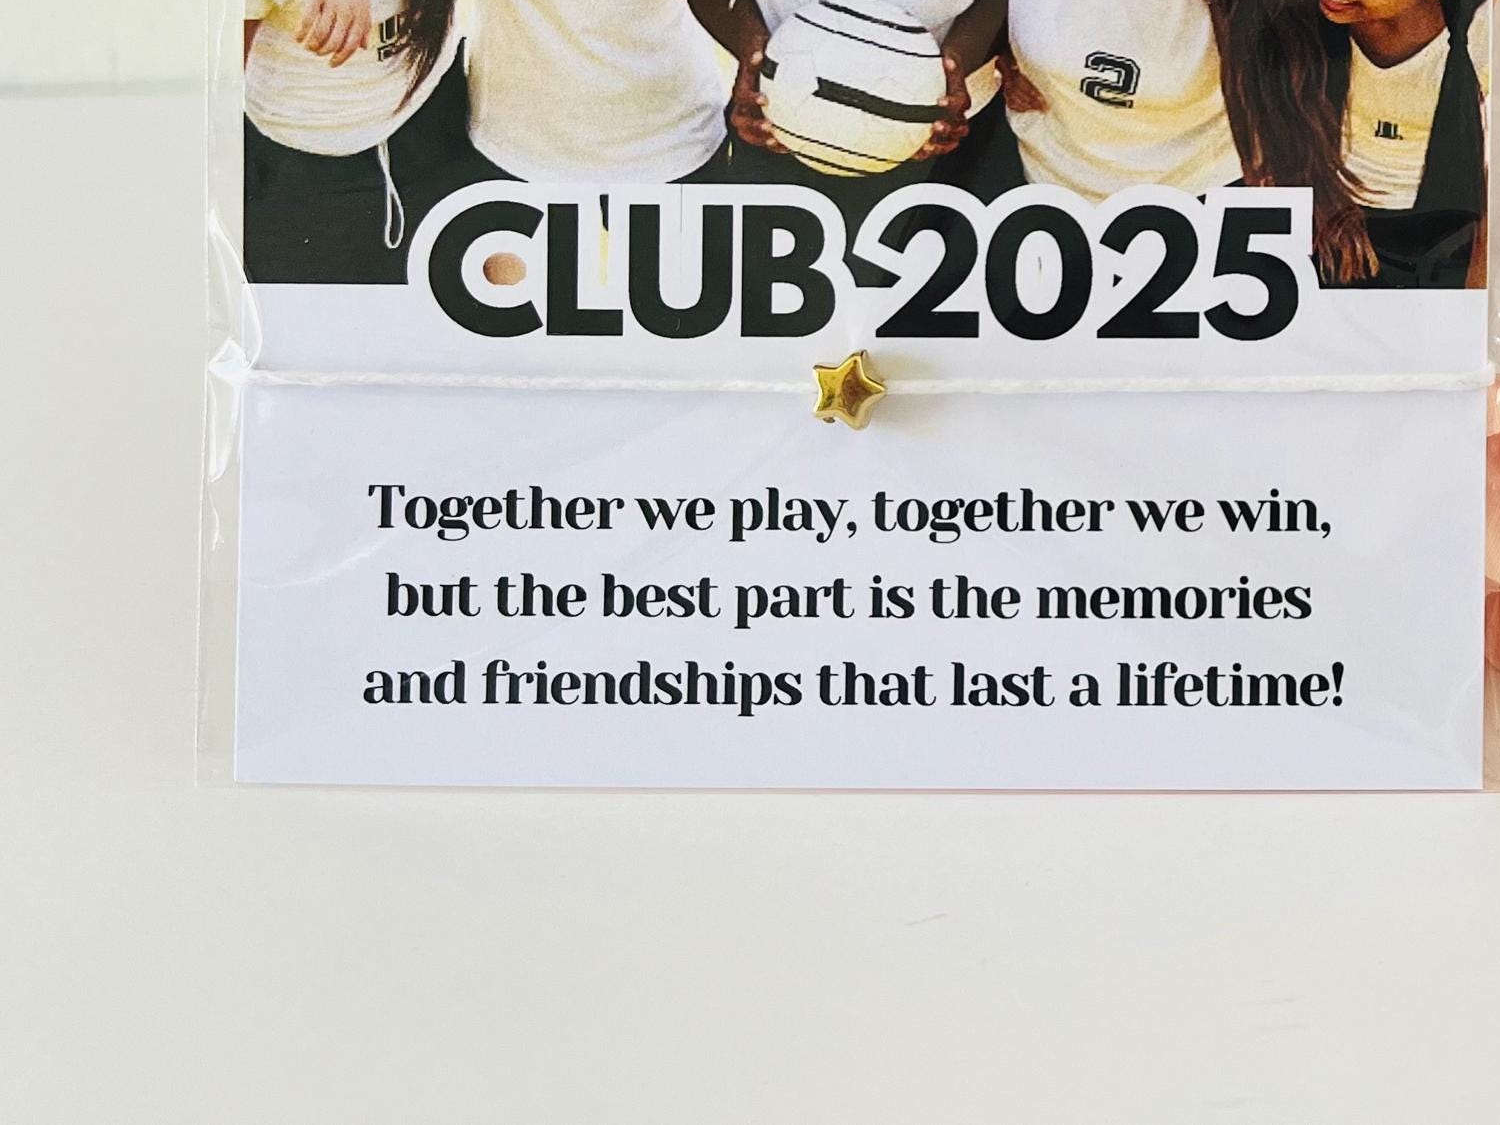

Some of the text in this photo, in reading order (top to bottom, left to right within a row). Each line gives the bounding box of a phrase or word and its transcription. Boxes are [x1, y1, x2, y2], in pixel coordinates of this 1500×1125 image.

[1080, 51, 1140, 109] 2
[427, 199, 1300, 341] CLUB 2025
[369, 485, 1330, 543] Together we play, together we win,
[386, 573, 1311, 629] but the best part is the memories
[364, 660, 1344, 716] and friendships that last a lifetime!
